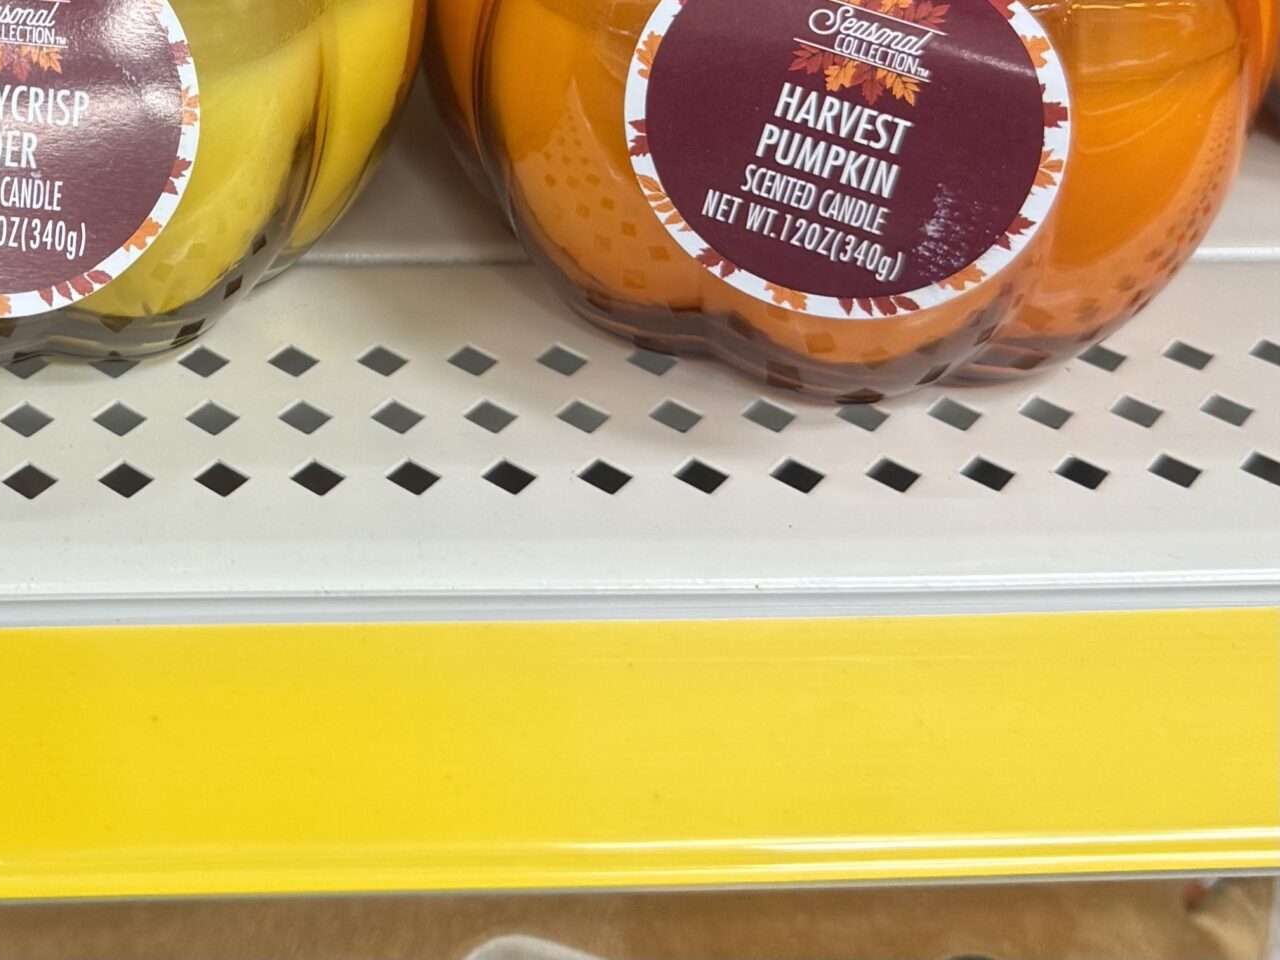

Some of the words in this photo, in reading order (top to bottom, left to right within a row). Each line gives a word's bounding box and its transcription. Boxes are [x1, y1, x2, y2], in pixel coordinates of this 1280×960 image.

[808, 6, 934, 55] Seasonal
[774, 82, 915, 155] HARVEST
[755, 123, 901, 199] PUMPKIN
[0, 176, 64, 211] CANDLE
[701, 189, 744, 225] NET
[740, 164, 818, 211] SCENTED
[818, 189, 891, 235] CANDLE
